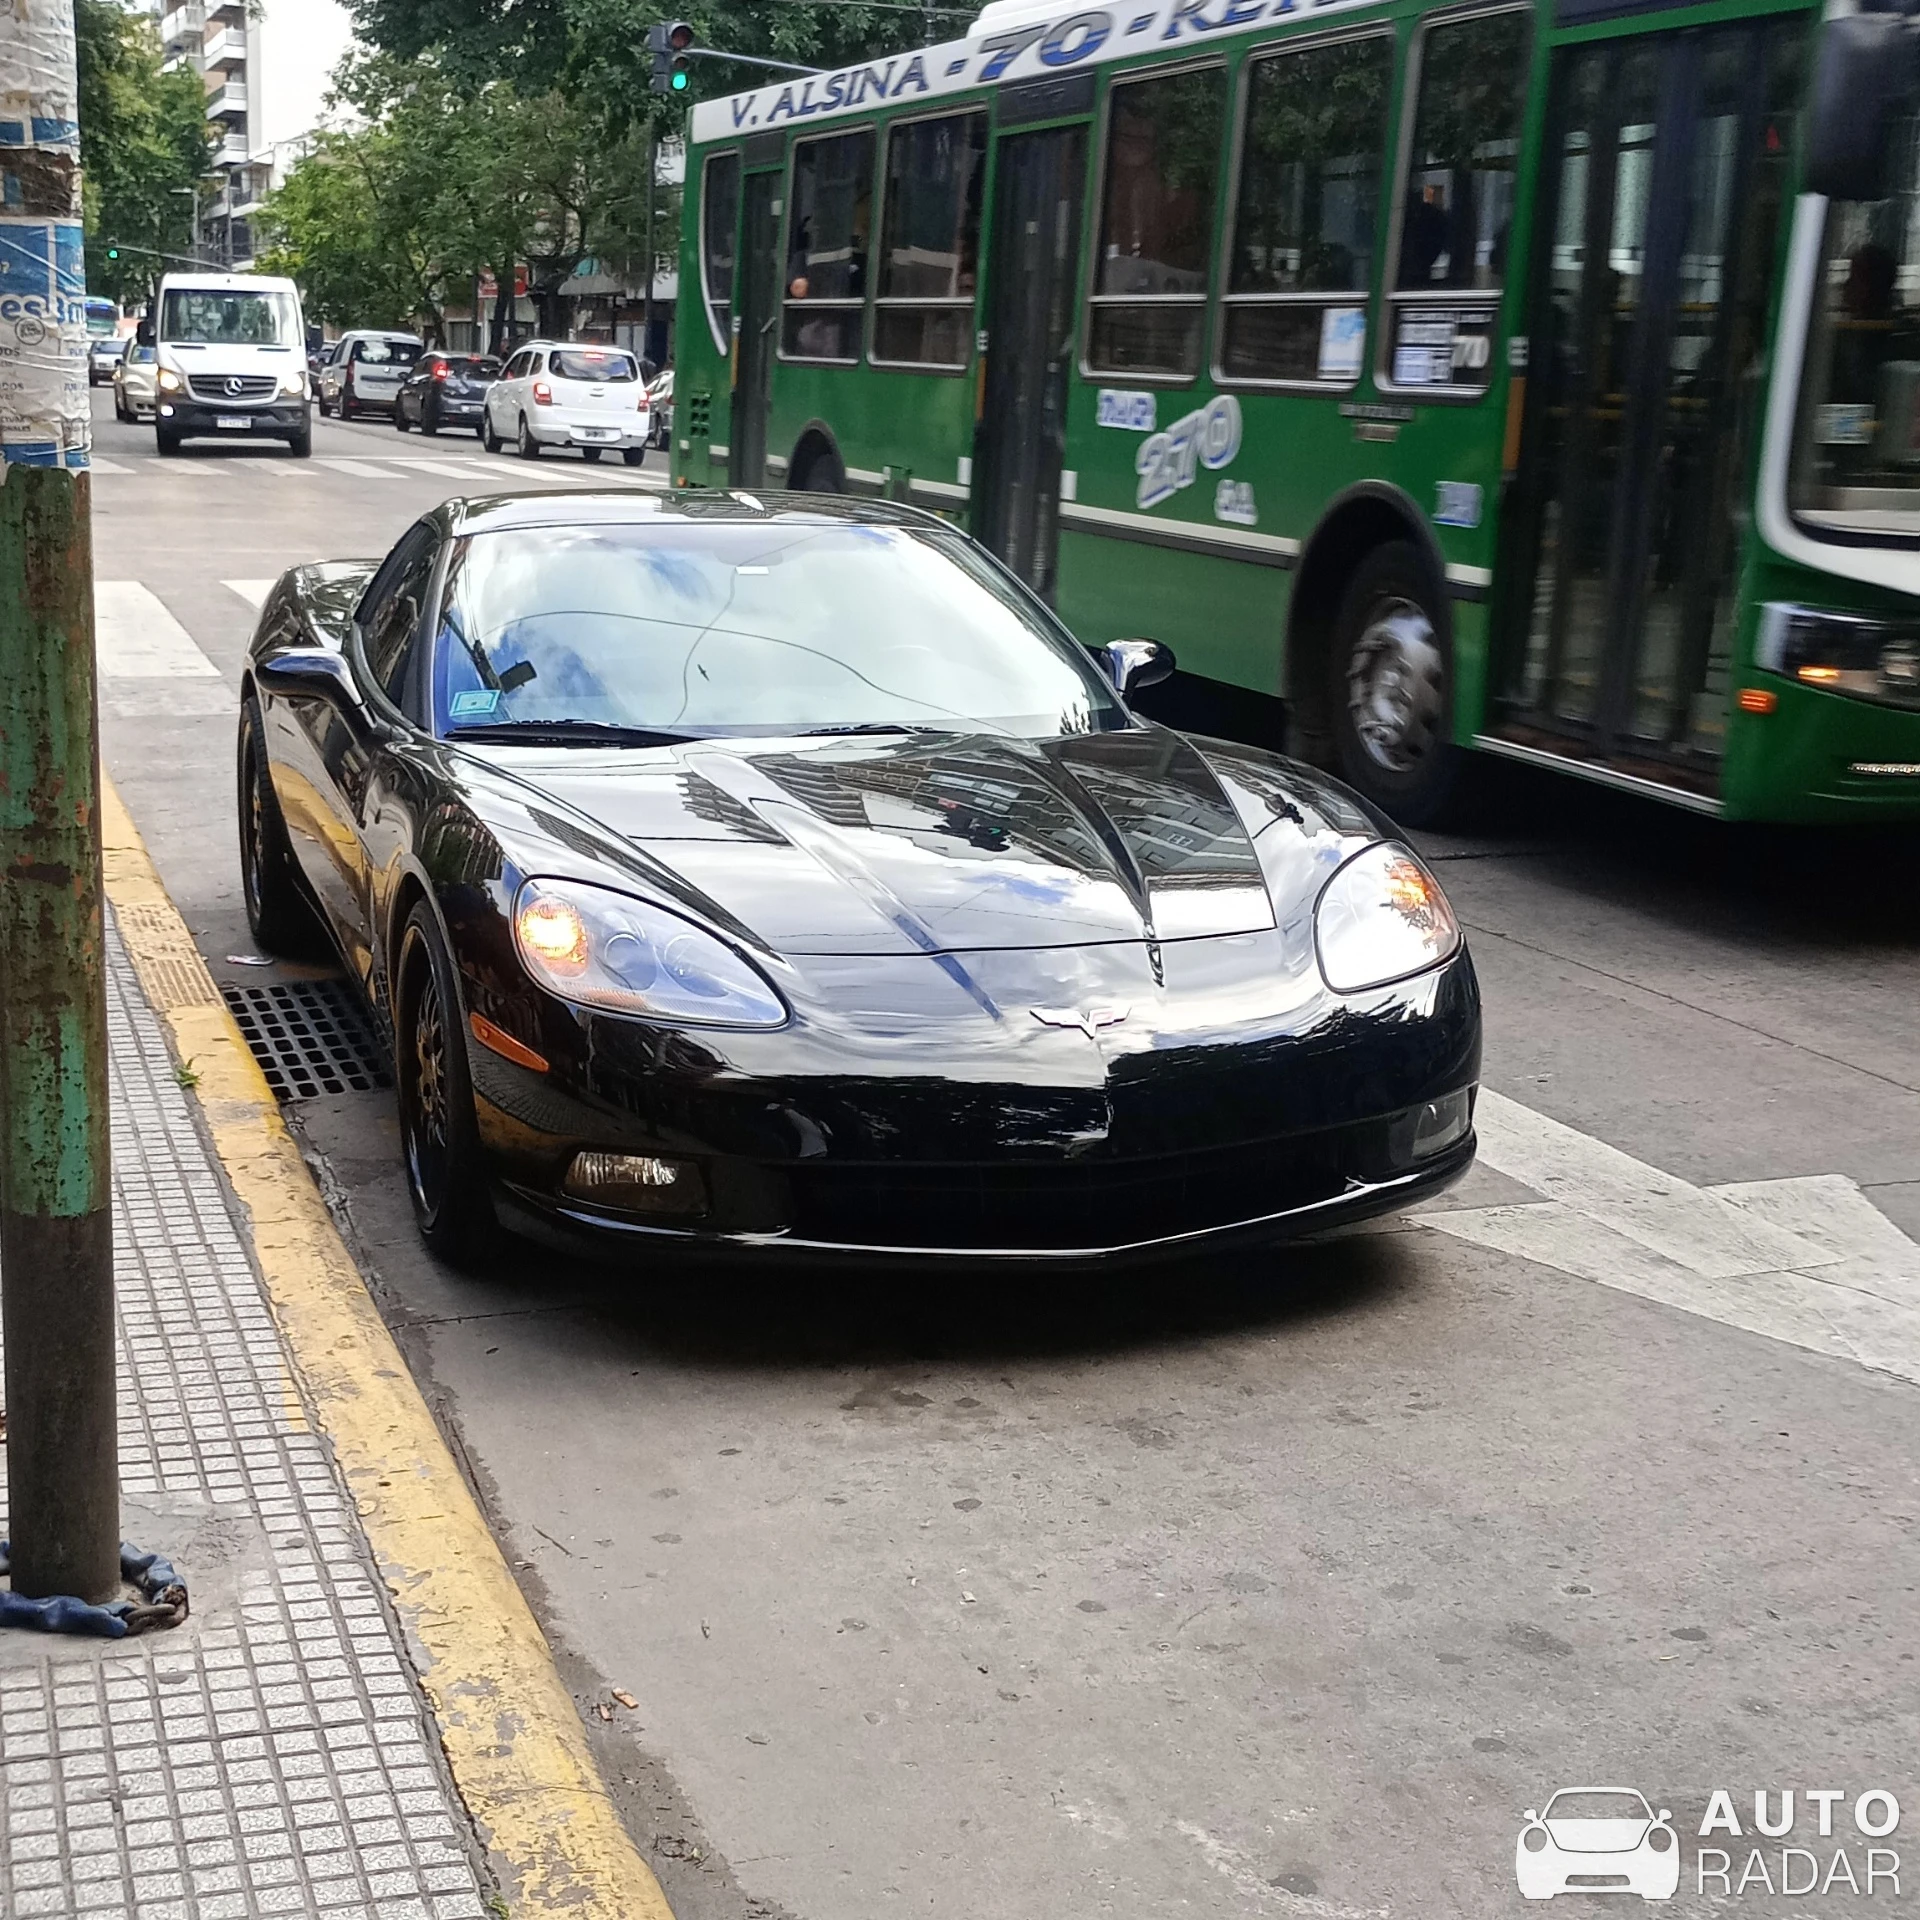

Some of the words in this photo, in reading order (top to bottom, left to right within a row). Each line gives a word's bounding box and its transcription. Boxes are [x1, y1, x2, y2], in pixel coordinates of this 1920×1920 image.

[731, 95, 757, 128] V.
[766, 56, 930, 123] ALSINA
[976, 11, 1114, 83] 70
